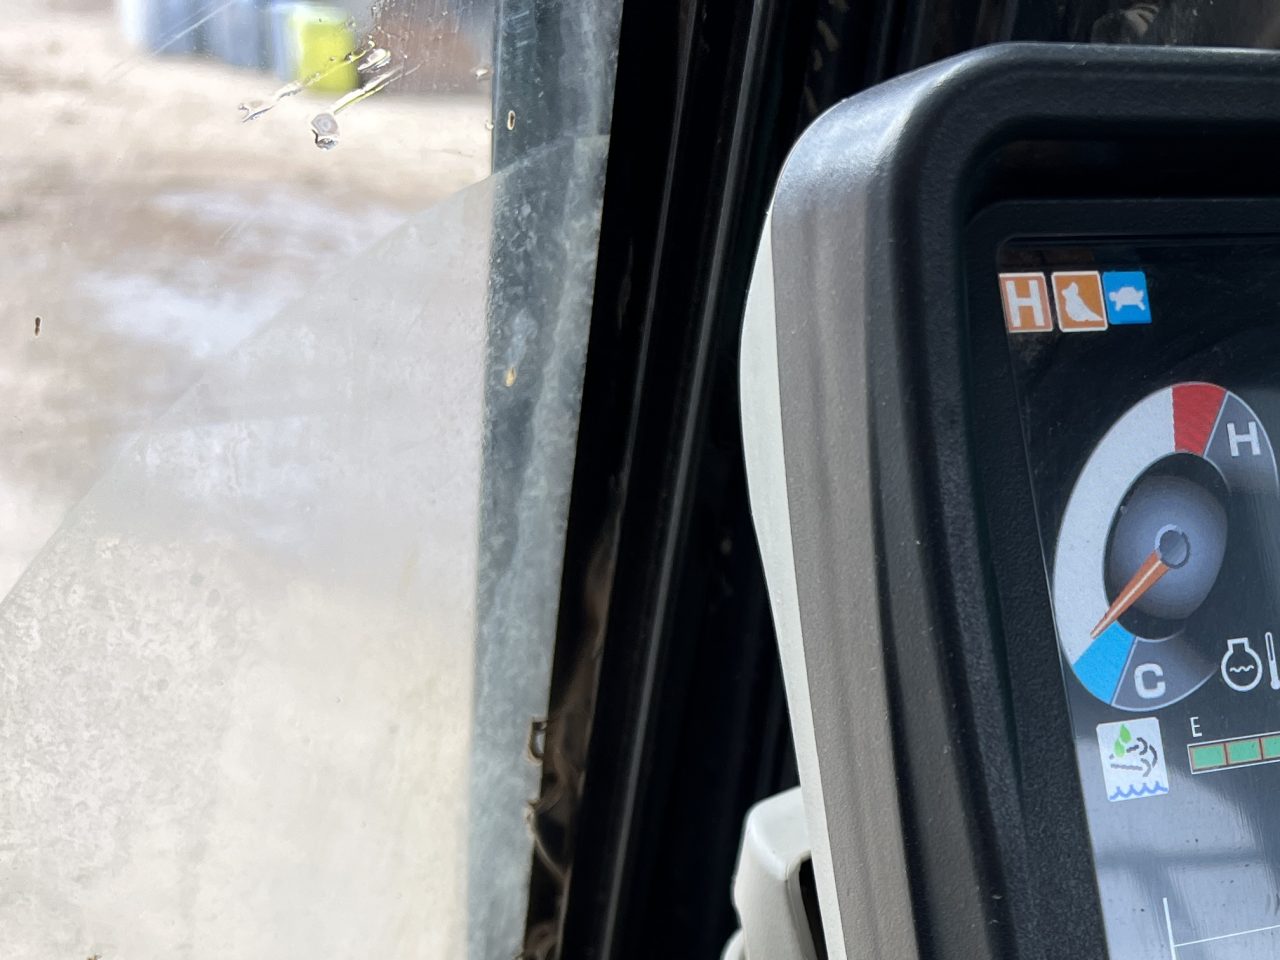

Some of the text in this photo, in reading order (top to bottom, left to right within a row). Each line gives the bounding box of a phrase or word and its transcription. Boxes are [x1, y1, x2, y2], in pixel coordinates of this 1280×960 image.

[1006, 279, 1047, 328] H
[1226, 421, 1262, 456] H
[1133, 663, 1166, 699] C
[1190, 716, 1202, 738] E
